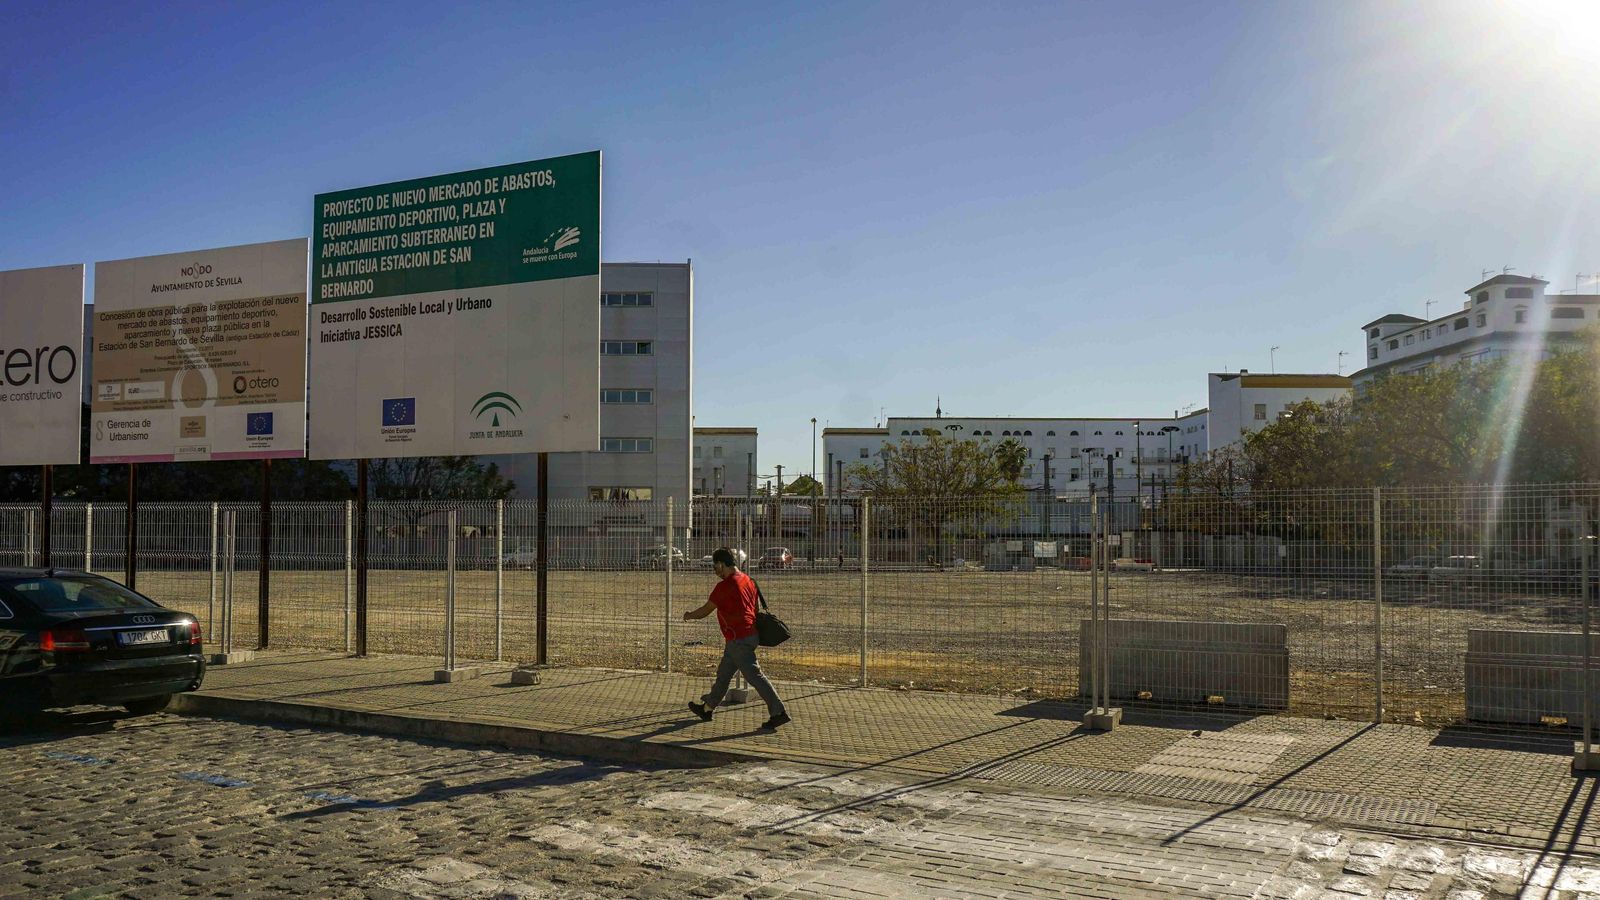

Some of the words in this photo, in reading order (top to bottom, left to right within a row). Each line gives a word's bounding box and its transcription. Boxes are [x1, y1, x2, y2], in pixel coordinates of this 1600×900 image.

[323, 197, 374, 218] PROYECTO
[376, 194, 389, 210] DE
[392, 188, 426, 208] NUEVO
[429, 180, 481, 202] MERCADO
[485, 178, 499, 194] DE
[502, 169, 556, 192] ABASTOS,
[323, 214, 396, 240] EQUIPAMIENTO
[400, 205, 459, 228] DEPORTIVO,
[463, 199, 496, 219] PLAZA
[499, 198, 506, 214] Y
[322, 234, 398, 258] APARCAMIENTO
[401, 223, 476, 248] SUBTERRANEO
[480, 221, 494, 238] EN
[322, 263, 333, 278] LA
[336, 258, 377, 276] ANTIGUA
[380, 251, 430, 271] ESTACION
[433, 249, 447, 265] DE
[450, 246, 471, 263] SAN
[530, 255, 548, 263] mueve
[558, 251, 577, 260] Europa
[205, 280, 214, 288] DE
[321, 279, 374, 298] BERNARDO
[100, 311, 135, 322] Concesión
[137, 310, 146, 318] de
[147, 309, 163, 318] obra
[164, 305, 190, 317] pública
[191, 304, 207, 315] para
[209, 303, 216, 311] la
[218, 299, 260, 312] explotación
[262, 296, 274, 306] del
[275, 296, 299, 305] nuevo
[320, 308, 367, 324] Desarrollo
[369, 304, 417, 320] Sostenible
[419, 299, 445, 315] Local
[447, 301, 453, 315] y
[456, 297, 492, 311] Urbano
[117, 321, 147, 330] mercado
[148, 319, 158, 327] de
[159, 317, 189, 326] abastos,
[191, 312, 240, 324] equipamiento
[241, 309, 278, 320] deportivo,
[124, 328, 171, 340] aparcamiento
[172, 329, 177, 338] y
[178, 326, 200, 335] nueva
[202, 323, 222, 334] plaza
[223, 321, 250, 333] pública
[251, 320, 261, 329] en
[263, 319, 270, 328] la
[320, 329, 361, 343] Iniciativa
[362, 323, 403, 339] JESSICA
[98, 341, 127, 352] Estación
[128, 340, 138, 350] de
[139, 339, 154, 349] San
[155, 337, 188, 347] Bernardo
[189, 335, 198, 344] de
[200, 334, 225, 344] Sevilla
[248, 376, 279, 389] otero
[10, 389, 63, 401] constructivo
[107, 419, 140, 429] Gerencia
[141, 418, 151, 428] de
[109, 432, 149, 441] Urbanismo
[469, 431, 485, 439] JUNTA
[486, 431, 493, 439] DE
